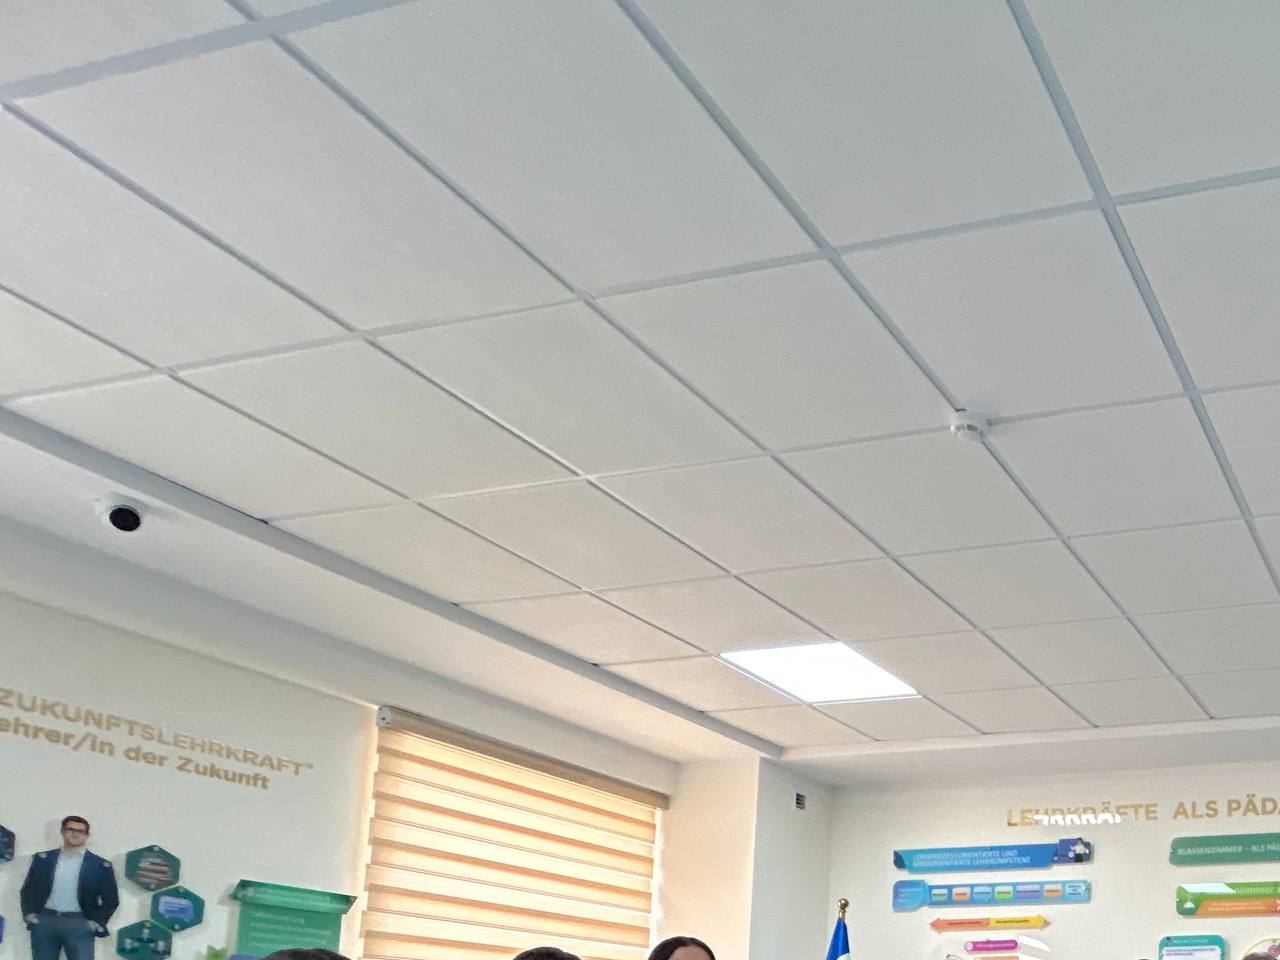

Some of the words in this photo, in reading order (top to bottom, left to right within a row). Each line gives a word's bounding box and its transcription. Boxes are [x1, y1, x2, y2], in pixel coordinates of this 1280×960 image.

[0, 716, 115, 756] ehrer/in
[124, 745, 170, 767] der
[176, 755, 271, 789] Zukunft
[1006, 801, 1158, 827] LEHRKRÄFTE
[1172, 799, 1219, 820] ALS
[1177, 845, 1243, 855] KLASSENZIMMER
[1251, 844, 1265, 852] ALS
